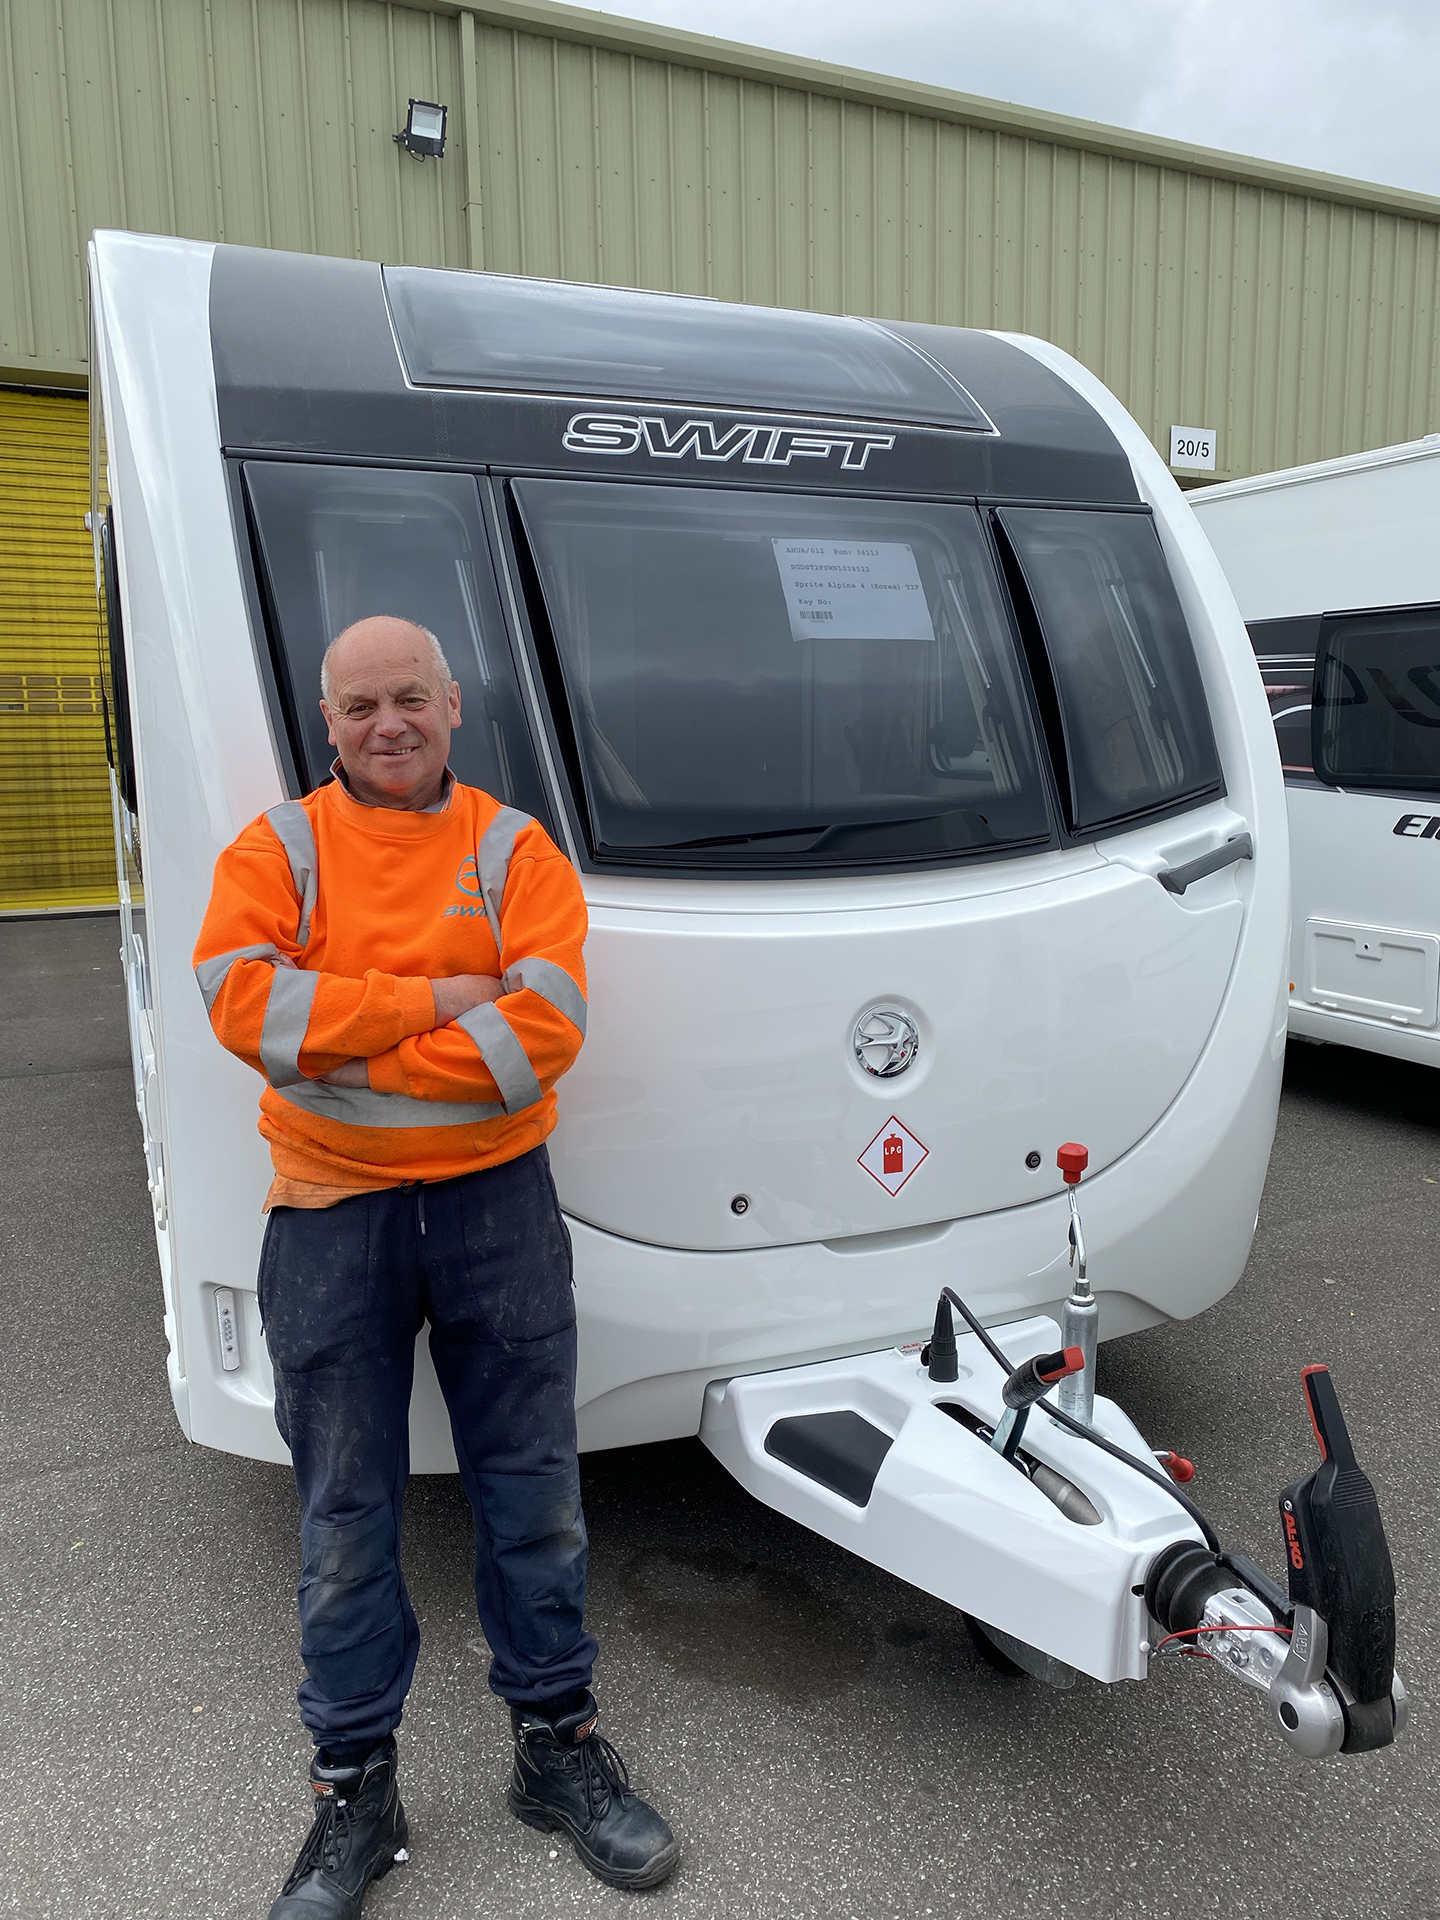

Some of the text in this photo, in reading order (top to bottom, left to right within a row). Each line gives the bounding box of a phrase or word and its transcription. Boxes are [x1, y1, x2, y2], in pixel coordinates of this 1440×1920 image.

[562, 412, 896, 471] SWIFT
[1177, 439, 1209, 457] 20/5
[794, 581, 824, 589] Sprite
[828, 582, 857, 590] Alpine
[870, 583, 901, 591] (Korea)
[798, 599, 813, 607] Key
[884, 1145, 902, 1155] LPG
[1283, 1511, 1304, 1570] AL-KO
